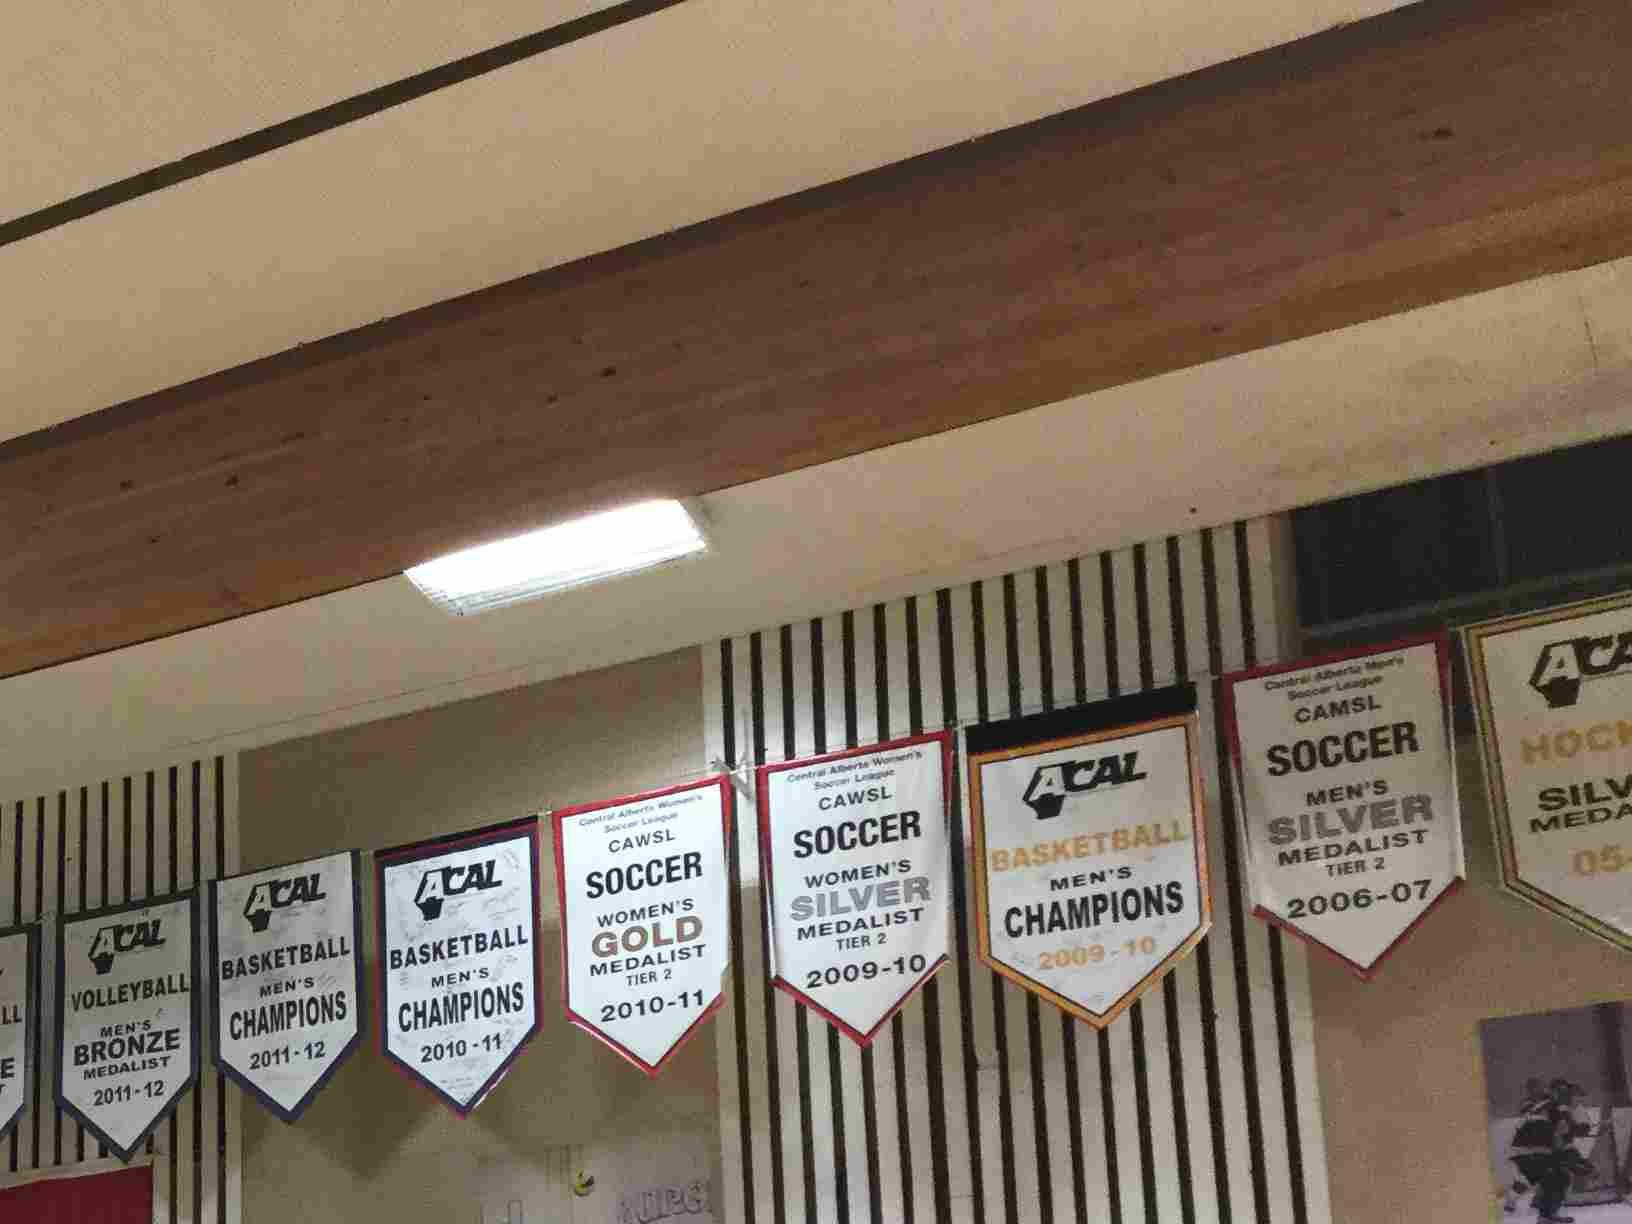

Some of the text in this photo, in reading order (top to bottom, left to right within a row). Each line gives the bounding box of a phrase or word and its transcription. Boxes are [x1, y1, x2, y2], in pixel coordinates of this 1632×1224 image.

[1295, 696, 1382, 723] CAMSL
[1267, 721, 1419, 777] SOCCER
[819, 786, 892, 810] CAWSL
[1306, 780, 1388, 807] MEN'S
[1538, 774, 1632, 811] SILV
[794, 811, 920, 858] SOCCER
[1268, 795, 1434, 846] SILVER
[1529, 804, 1632, 832] MEDA
[608, 828, 676, 852] CAWSL
[992, 819, 1185, 872] BASKETBALL
[1278, 830, 1429, 866] MEDALIST
[586, 852, 703, 899] SOCCER
[805, 860, 911, 888] WOMEN'S
[1050, 867, 1132, 891] MEN'S
[1326, 857, 1385, 877] TIER 2
[597, 899, 694, 928] WOMEN'S
[791, 877, 930, 921] SILVER
[1005, 881, 1184, 938] CHAMPIONS
[1287, 879, 1432, 919] 2006-07
[592, 915, 703, 958] GOLD
[798, 908, 924, 940] MEDALIST
[222, 936, 350, 980] BASKETBALL
[390, 926, 528, 969] BASKETBALL
[836, 933, 887, 951] TIER 2
[431, 967, 489, 987] MEN'S
[590, 945, 706, 976] MEDALIST
[807, 954, 926, 988] 2009-10
[72, 974, 190, 1011] VOLLEYBALL
[259, 977, 314, 997] MEN'S
[626, 969, 672, 986] TIER 2
[230, 991, 346, 1040] CHAMPIONS
[398, 982, 524, 1032] CHAMPIONS
[600, 990, 704, 1022] 2010-11
[100, 1020, 151, 1038] MEN'S
[74, 1028, 181, 1066] BRONZE
[84, 1056, 171, 1080] MEDALIST
